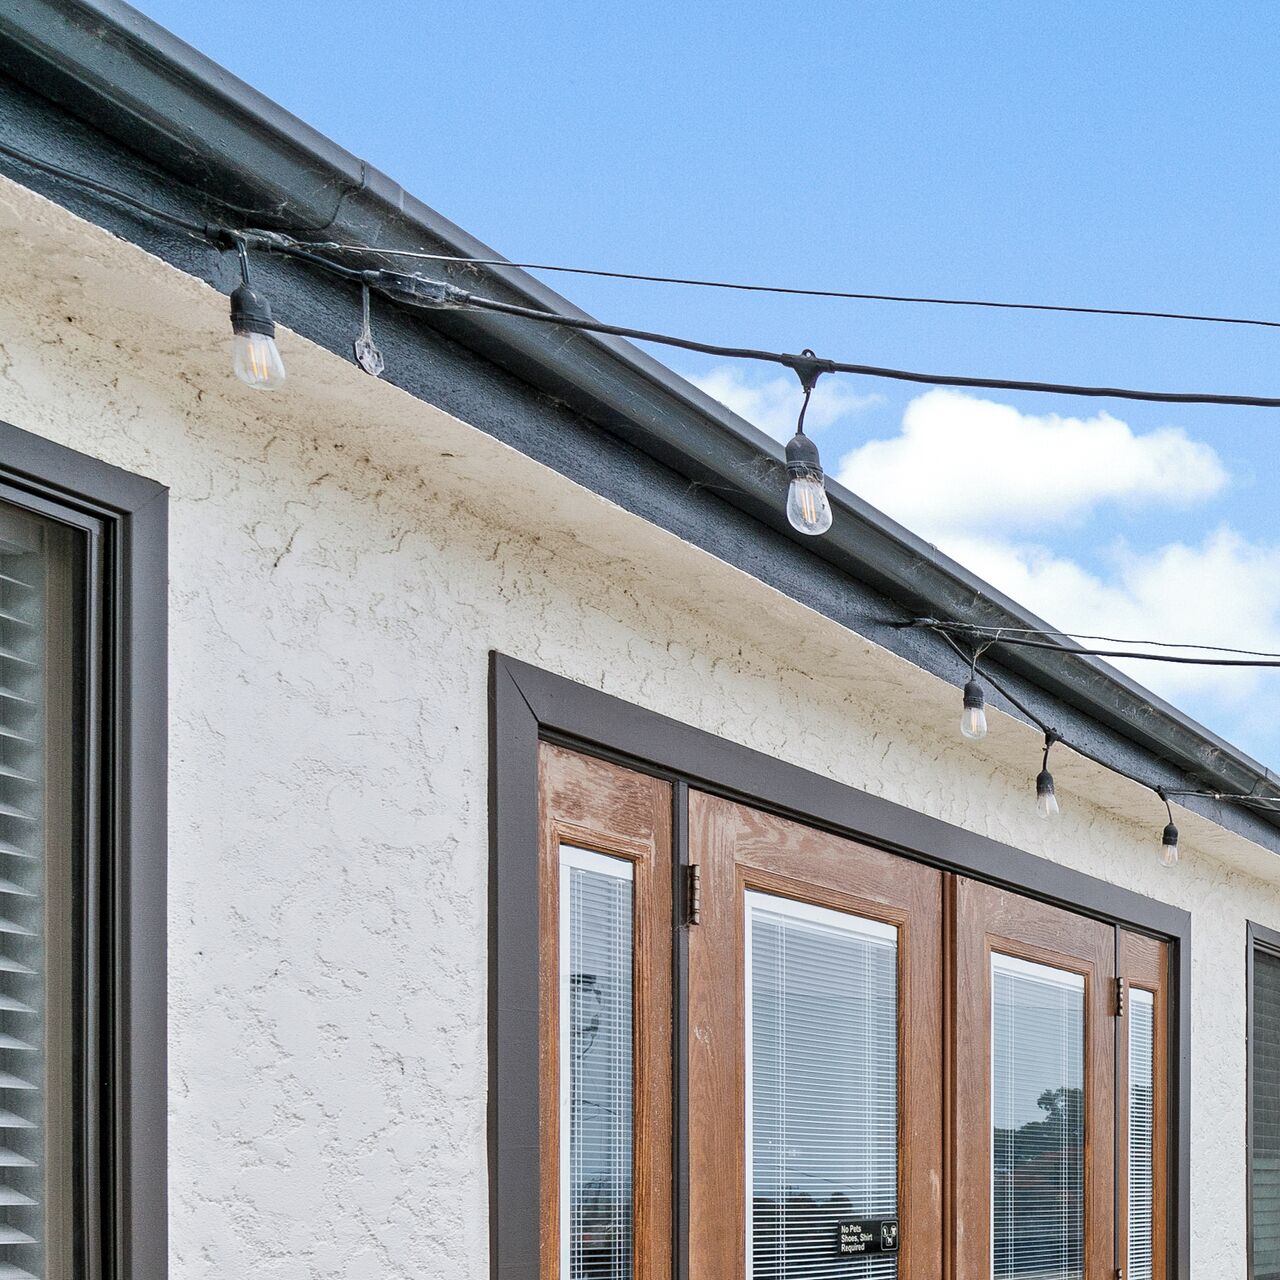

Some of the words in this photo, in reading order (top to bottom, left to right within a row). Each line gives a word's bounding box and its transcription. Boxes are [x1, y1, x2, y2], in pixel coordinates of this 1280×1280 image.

[841, 1225, 849, 1233] No
[841, 1234, 859, 1243] Shoes,
[860, 1233, 873, 1241] Shirt
[841, 1243, 865, 1253] Required
